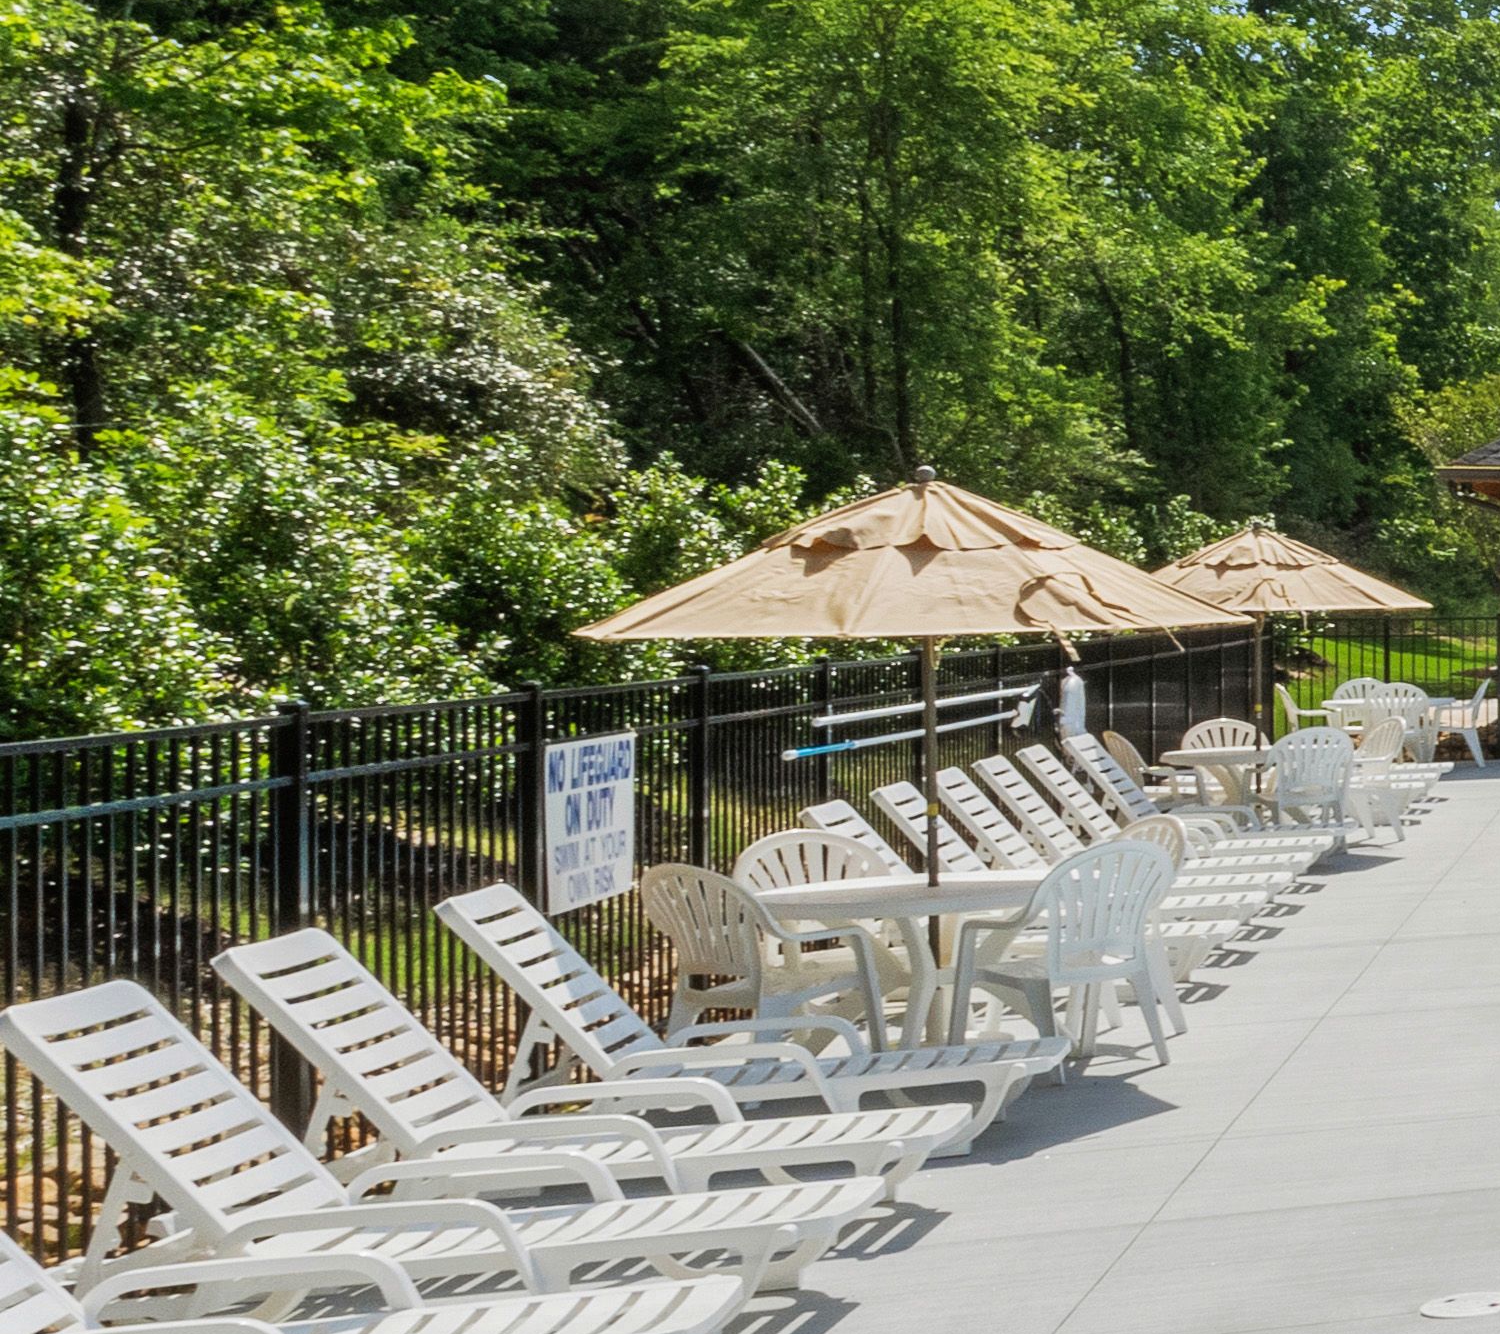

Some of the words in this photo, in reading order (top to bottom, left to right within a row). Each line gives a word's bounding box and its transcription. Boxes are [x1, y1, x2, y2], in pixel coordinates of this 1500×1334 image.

[548, 749, 566, 793] NO
[571, 740, 631, 789] LIFEGUARD
[565, 793, 581, 836] ON
[587, 785, 616, 832] DUTY
